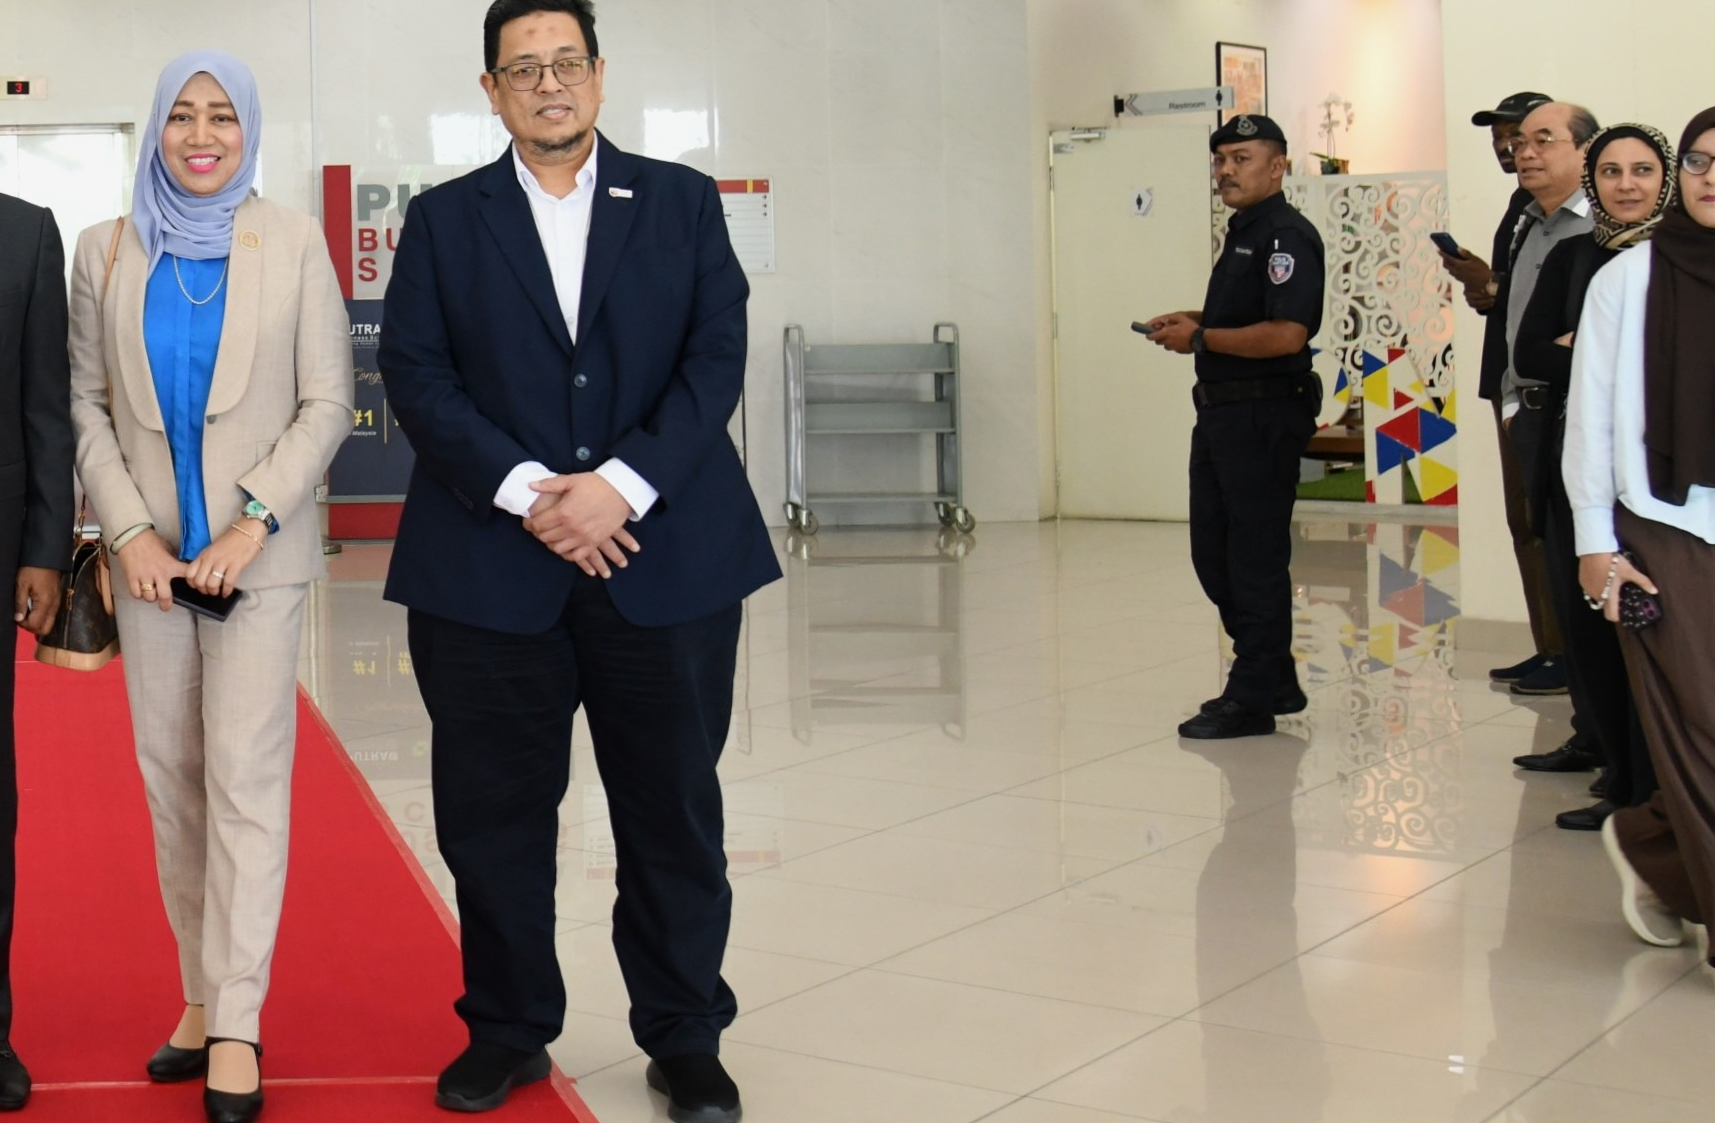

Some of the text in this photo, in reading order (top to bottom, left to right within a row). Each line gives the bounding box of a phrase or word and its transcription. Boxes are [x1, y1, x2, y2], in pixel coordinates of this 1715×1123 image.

[15, 82, 23, 93] 3
[1168, 101, 1206, 110] Restroom
[358, 257, 378, 282] S
